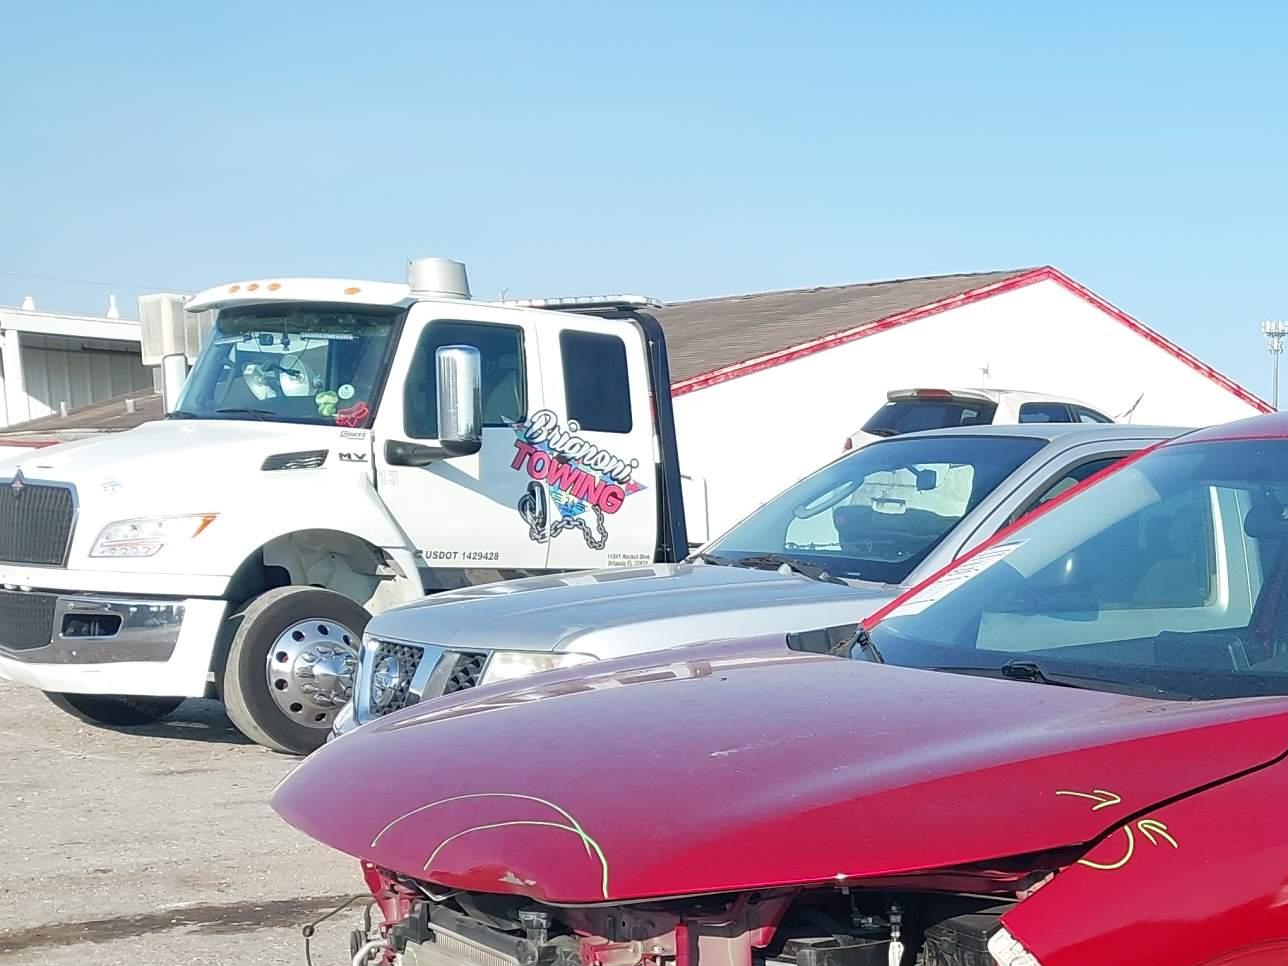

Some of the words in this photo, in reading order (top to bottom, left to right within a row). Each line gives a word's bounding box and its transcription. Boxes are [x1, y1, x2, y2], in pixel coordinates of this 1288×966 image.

[338, 452, 367, 460] MV
[511, 439, 626, 514] TOWING
[425, 550, 458, 560] USDOT
[462, 551, 499, 561] 1429428
